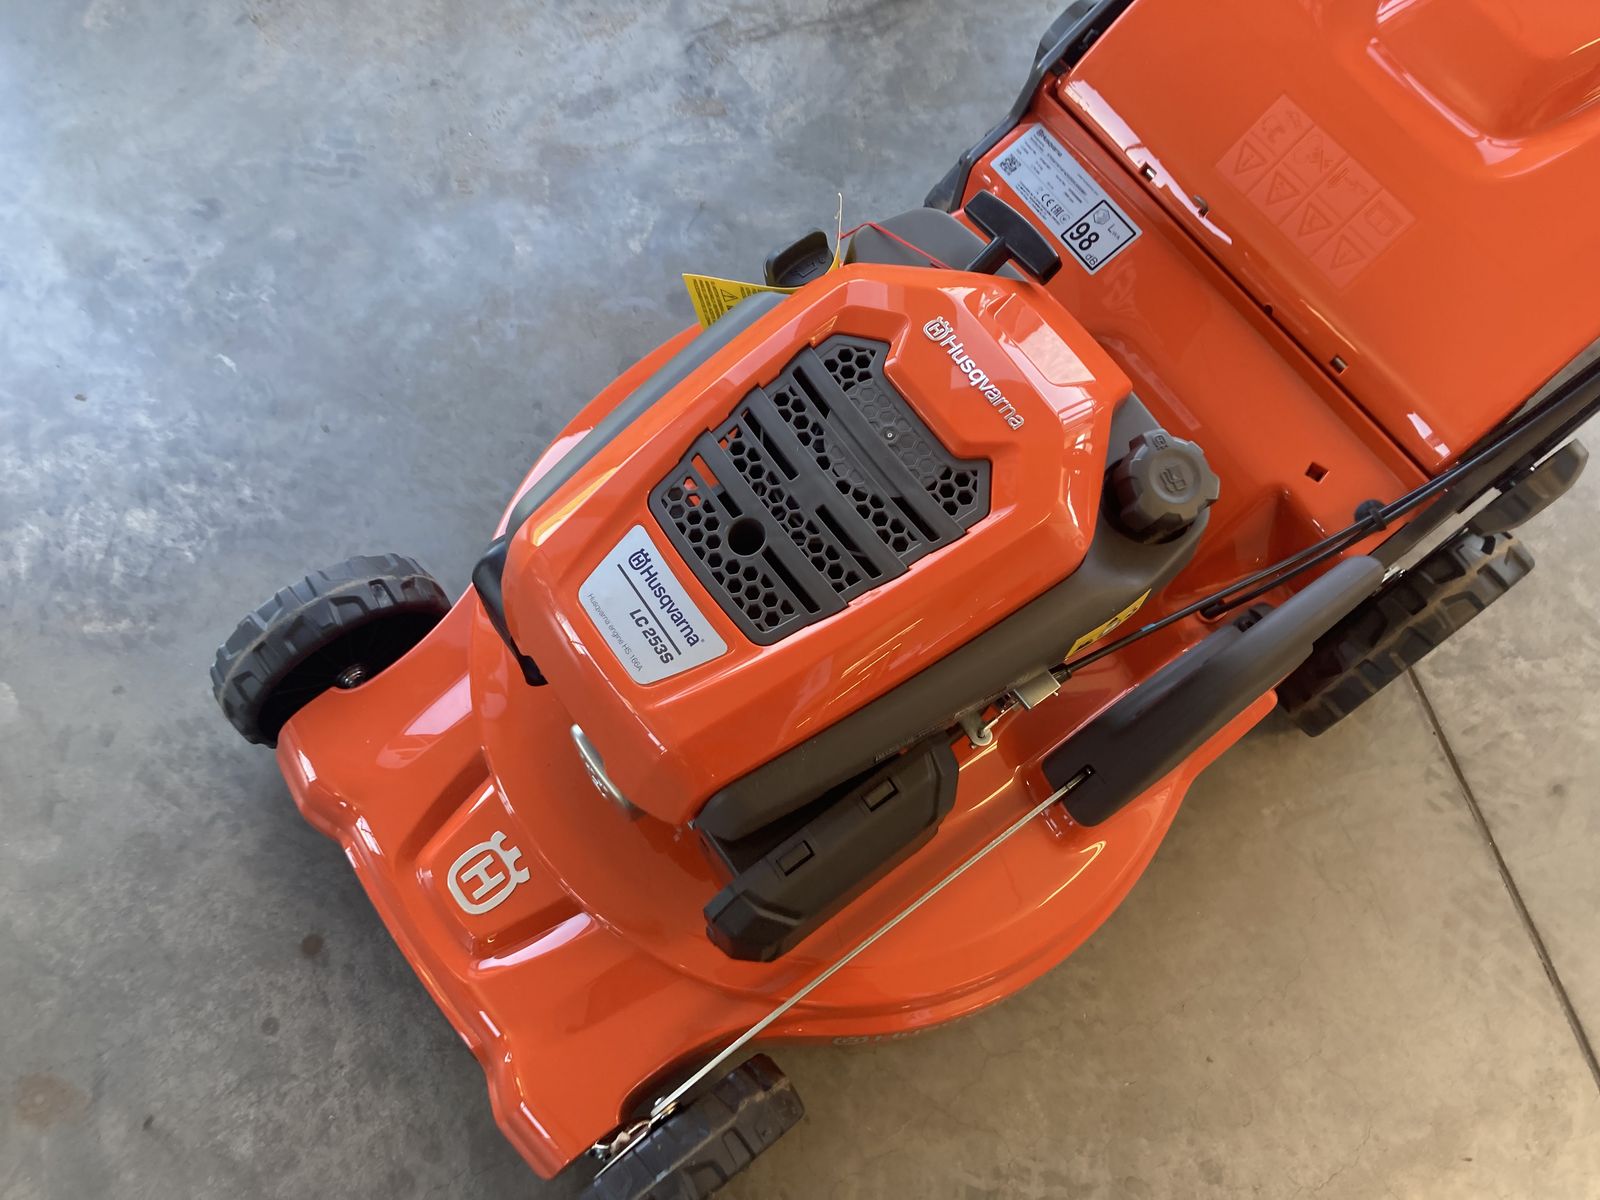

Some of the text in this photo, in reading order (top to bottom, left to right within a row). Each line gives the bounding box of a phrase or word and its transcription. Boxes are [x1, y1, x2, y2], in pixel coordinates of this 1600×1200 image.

[1069, 222, 1100, 251] 98
[1085, 253, 1099, 266] dB
[939, 334, 1025, 430] Husqvarna
[587, 594, 643, 672] Husqvarna engine HS 166A
[629, 608, 675, 664] LC 253S
[639, 564, 700, 647] Husqvarna
